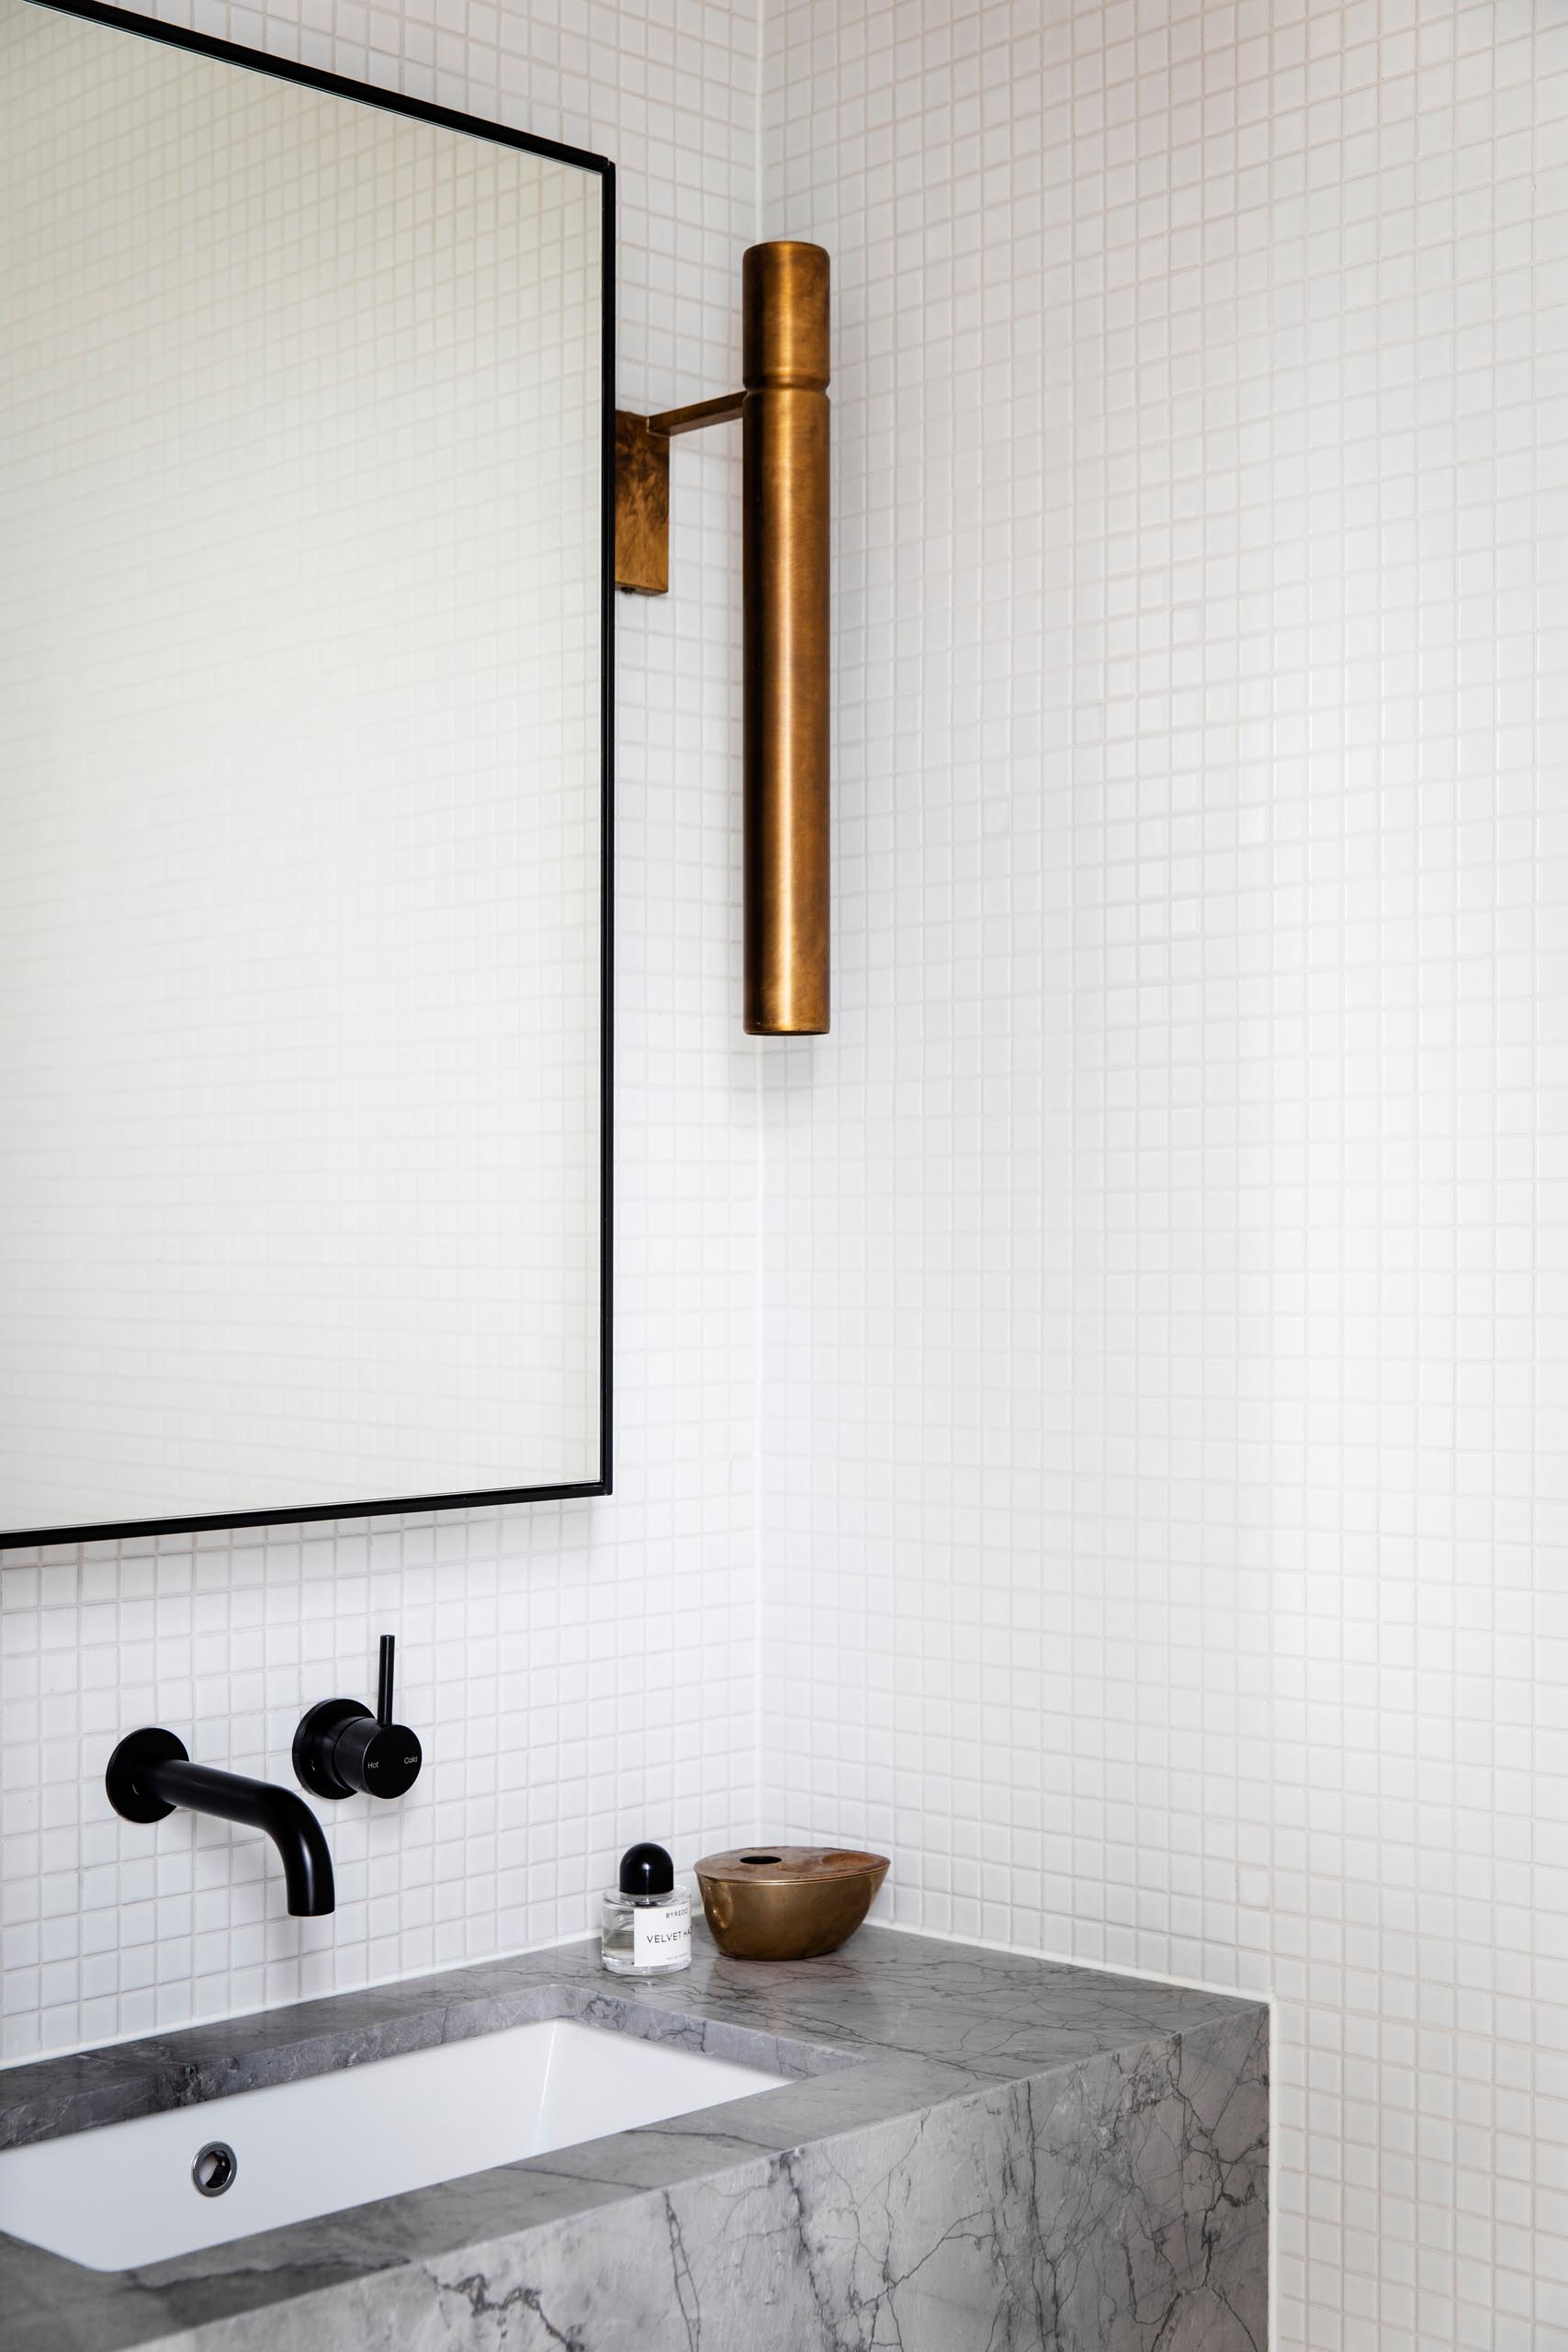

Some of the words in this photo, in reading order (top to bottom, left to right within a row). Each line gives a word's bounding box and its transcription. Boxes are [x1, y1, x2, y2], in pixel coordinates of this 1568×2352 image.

[404, 1756, 418, 1764] Cold
[367, 1761, 379, 1770] Hot
[647, 1931, 682, 1943] VELVET
